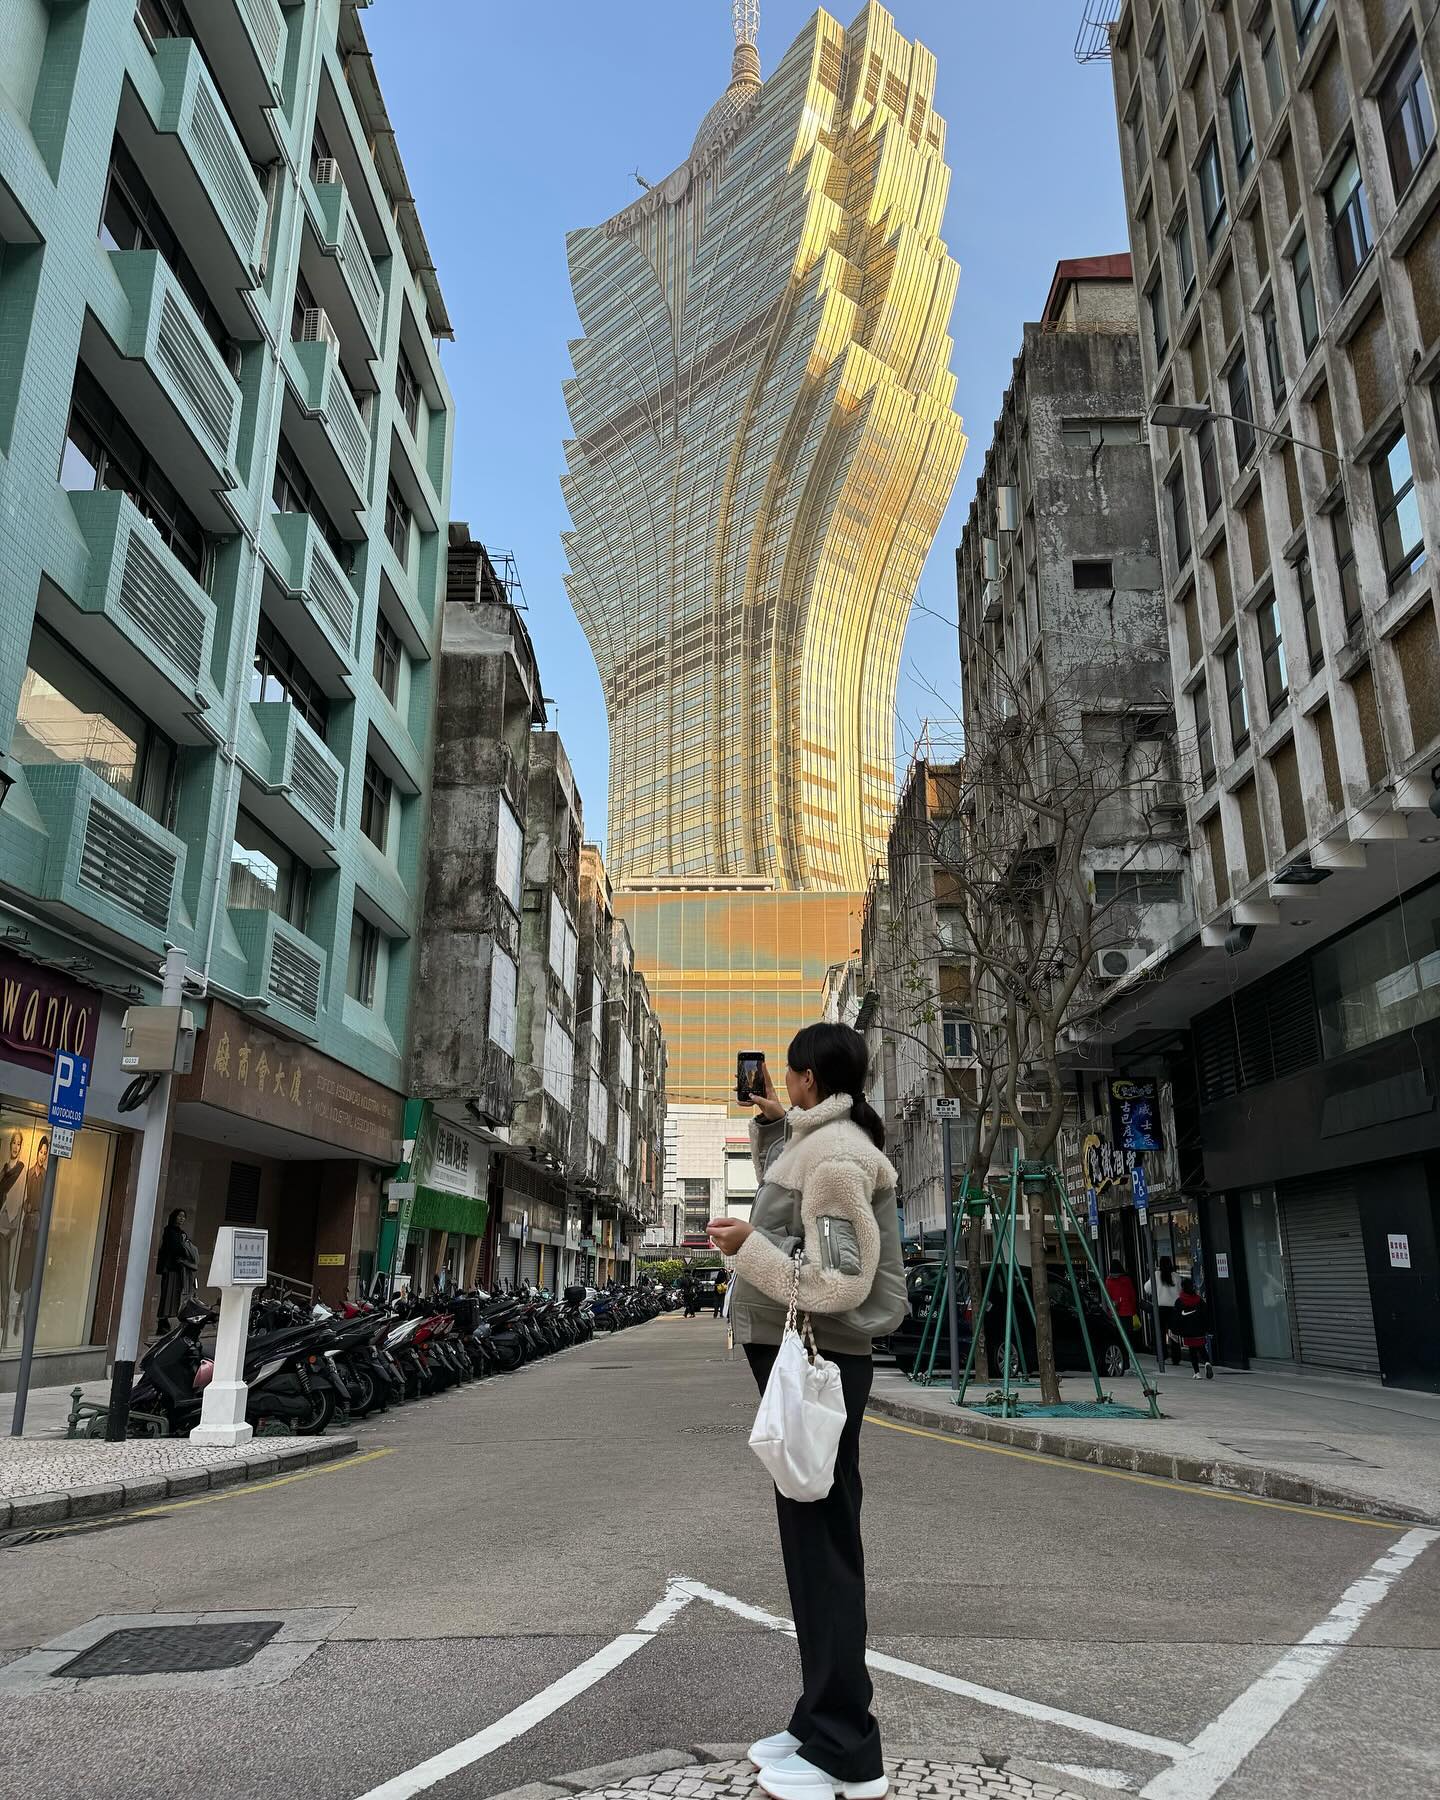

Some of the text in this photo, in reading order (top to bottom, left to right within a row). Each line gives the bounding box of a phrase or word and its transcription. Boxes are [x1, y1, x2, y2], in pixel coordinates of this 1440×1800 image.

[52, 1055, 74, 1104] P
[51, 1105, 82, 1121] MOTOCICLOS
[1120, 1101, 1136, 1148] 古巴產品
[1139, 1103, 1154, 1146] 威士忌
[1131, 1170, 1139, 1194] P
